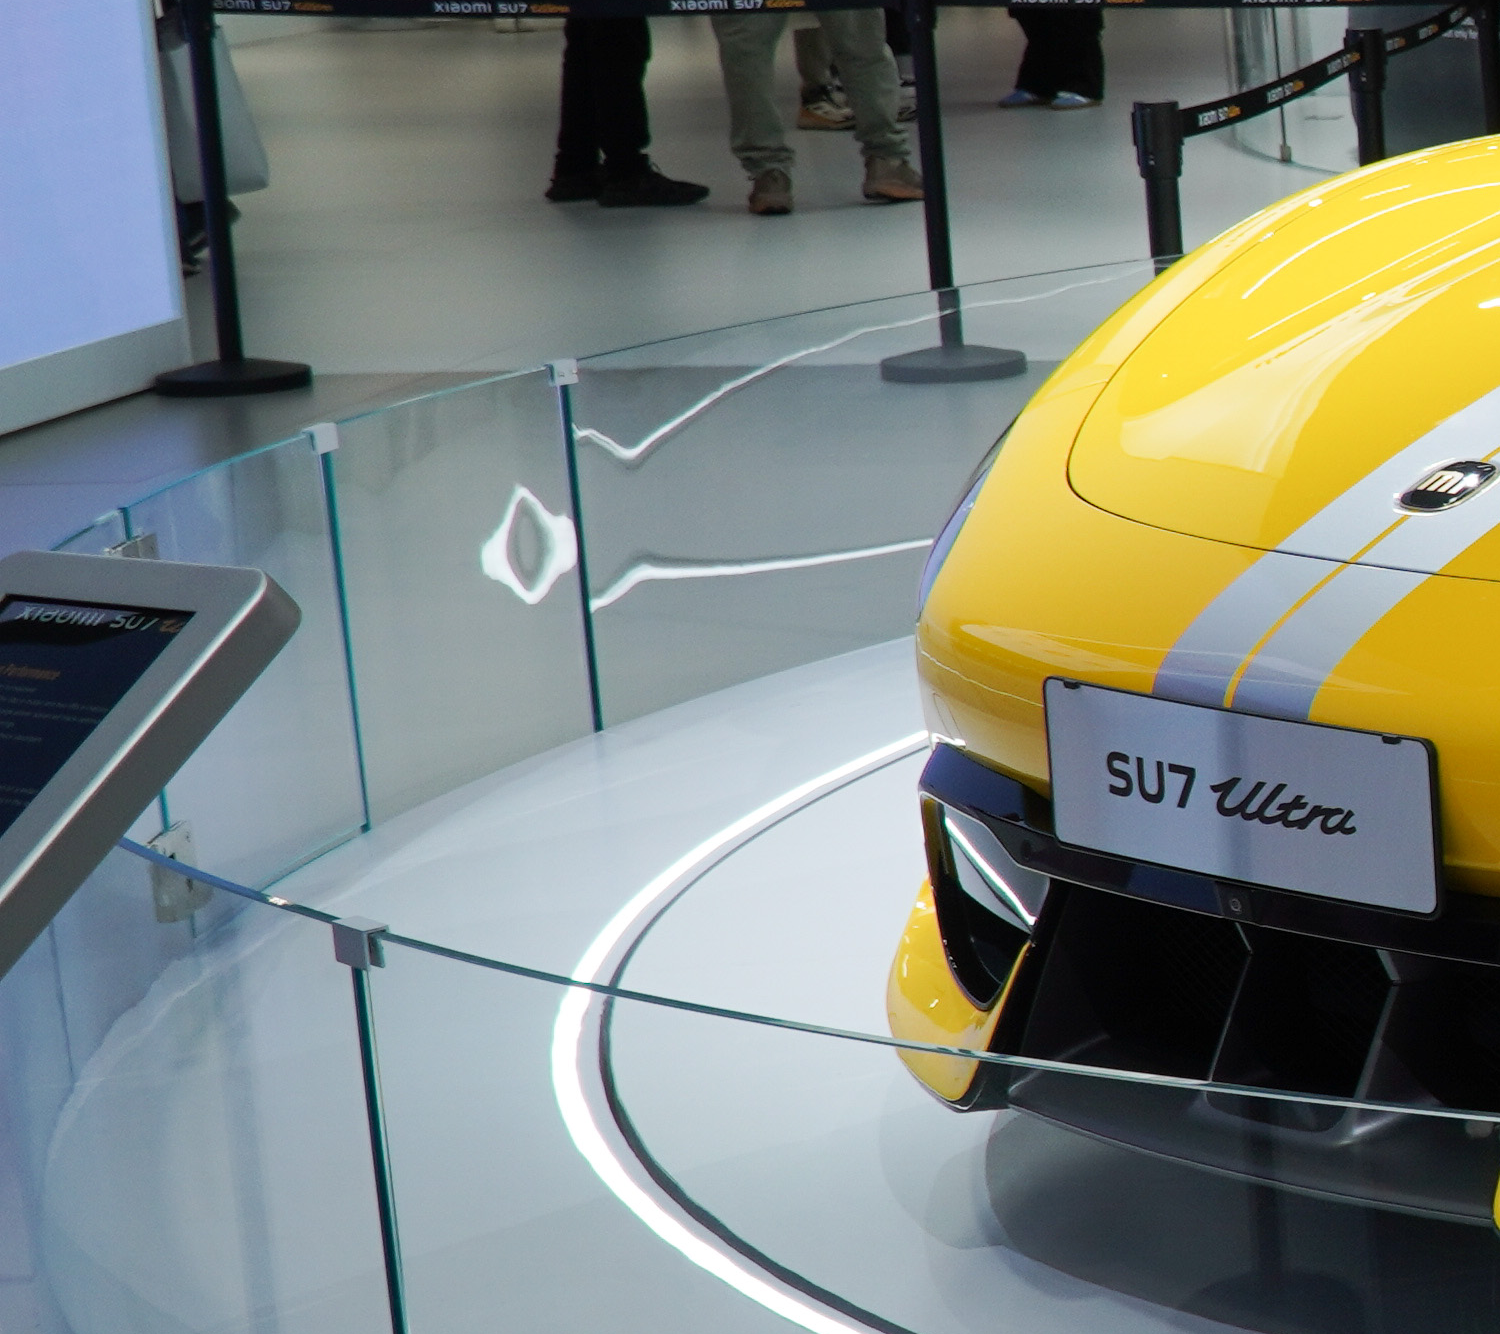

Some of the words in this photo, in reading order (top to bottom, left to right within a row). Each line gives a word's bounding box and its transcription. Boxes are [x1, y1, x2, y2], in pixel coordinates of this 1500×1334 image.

[498, 2, 529, 15] SU7
[1106, 751, 1197, 809] SU7
[1210, 777, 1358, 836] Ultra
